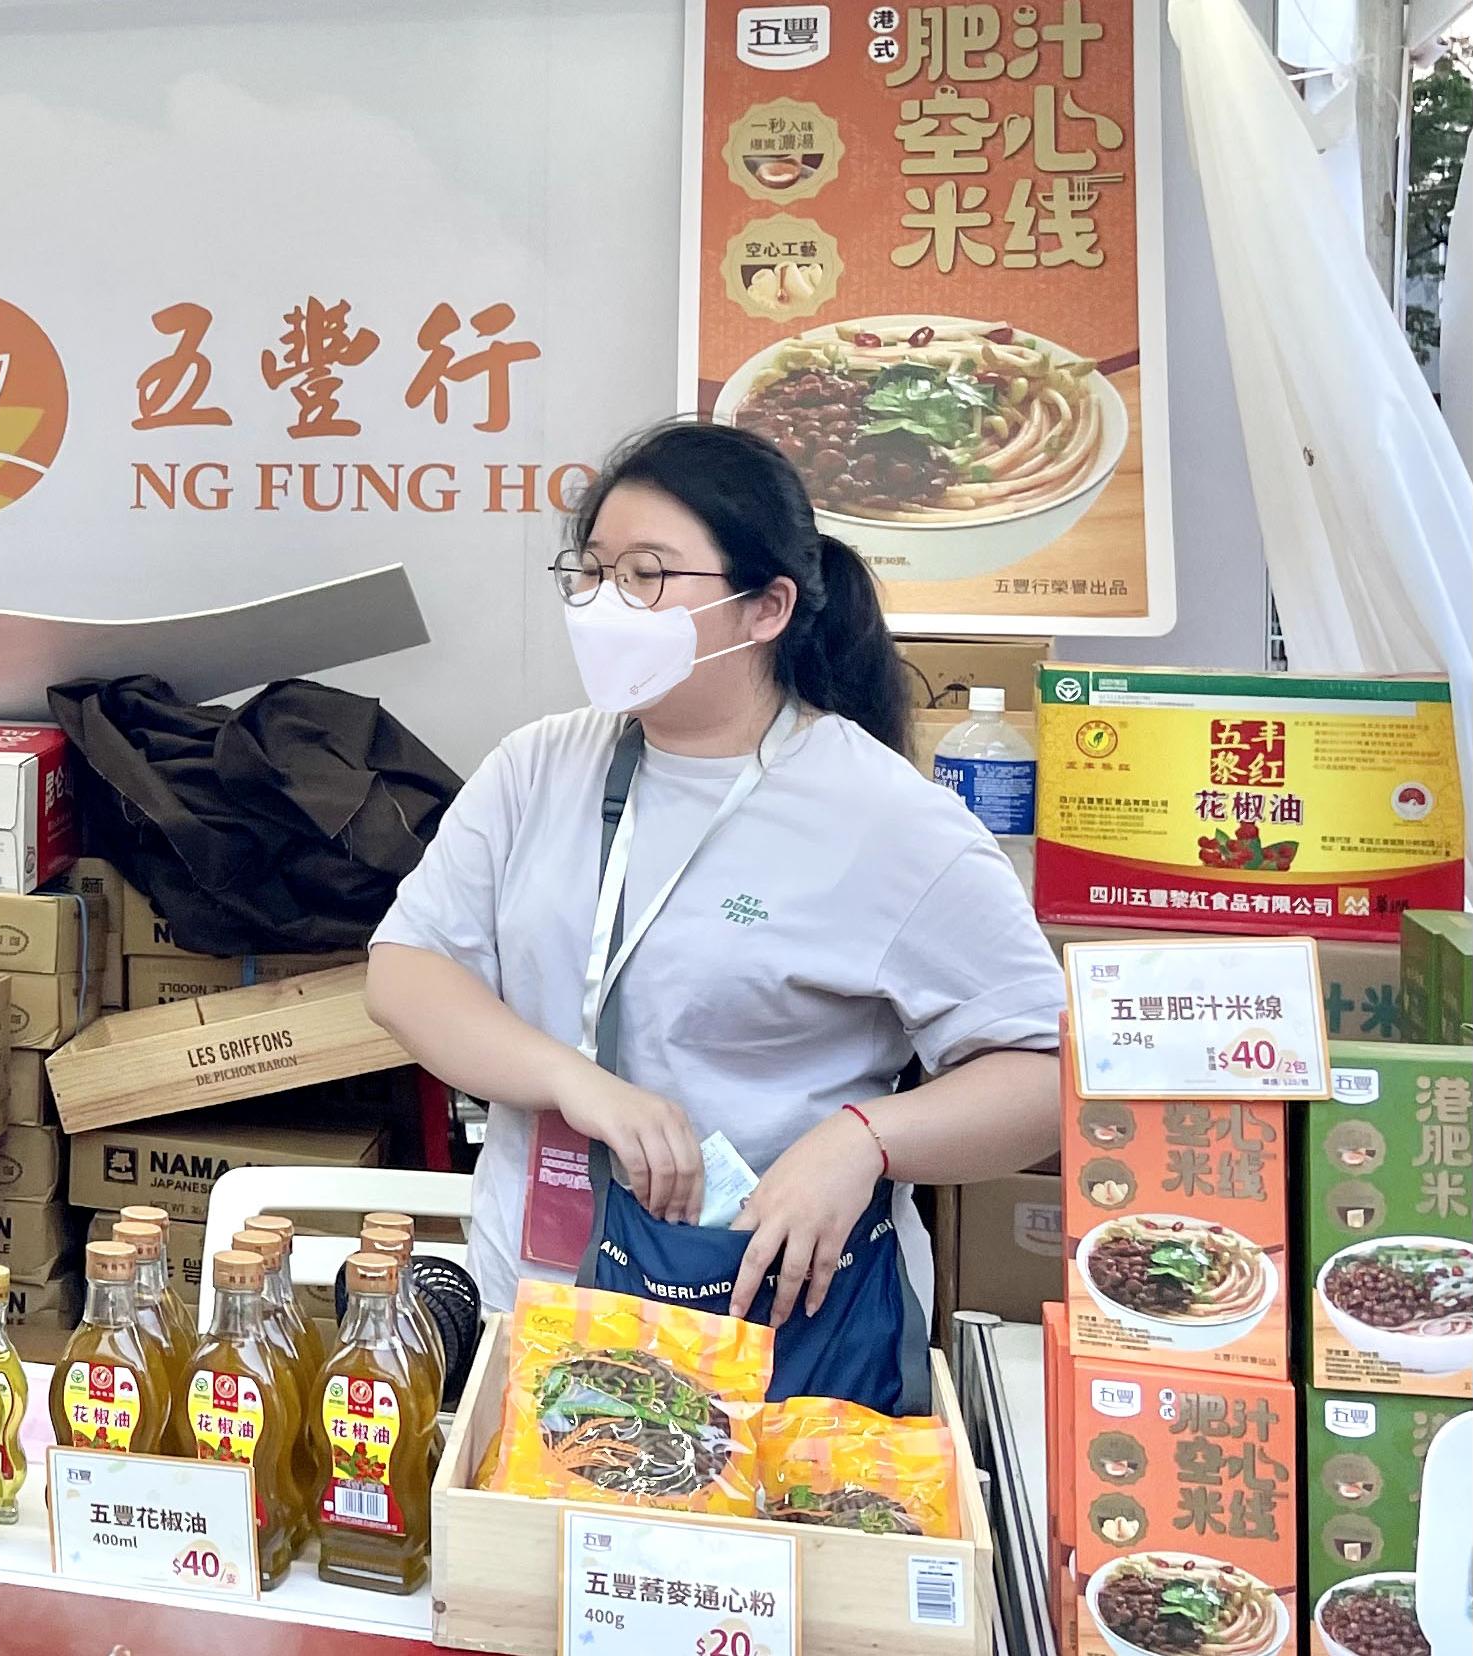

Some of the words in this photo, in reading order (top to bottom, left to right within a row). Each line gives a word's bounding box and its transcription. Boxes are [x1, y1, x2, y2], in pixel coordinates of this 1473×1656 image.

[886, 0, 1103, 87] 肥汁
[894, 86, 1124, 174] 空心
[890, 176, 1110, 274] 米线
[131, 295, 541, 439] 五豐行
[130, 461, 234, 511] NG
[253, 461, 462, 513] FUNG
[1194, 789, 1304, 825] 花椒油
[736, 893, 763, 907] FLY
[1089, 886, 1333, 917] 四川五豐黎紅食品有限公司
[1111, 995, 1283, 1022] 五豐肥汁米線
[187, 1046, 216, 1068] LES
[219, 1030, 293, 1061] GRIFFONS
[1112, 1031, 1155, 1050] 294g
[196, 1073, 212, 1087] DE
[213, 1063, 257, 1083] PICHON
[257, 1054, 299, 1074] BARON
[150, 1150, 229, 1180] NAMA
[73, 1403, 132, 1429] 花椒油
[196, 1412, 255, 1440] 花椒油
[331, 1418, 391, 1446] 花椒油
[1169, 1392, 1279, 1443] 肥汁
[1173, 1435, 1289, 1487] 空心
[89, 1502, 208, 1535] 五豐花椒油
[1172, 1486, 1283, 1542] 米线
[92, 1532, 139, 1549] 400ml
[584, 1571, 777, 1618] 五豐蕎麥通心粉
[584, 1608, 625, 1629] 400g
